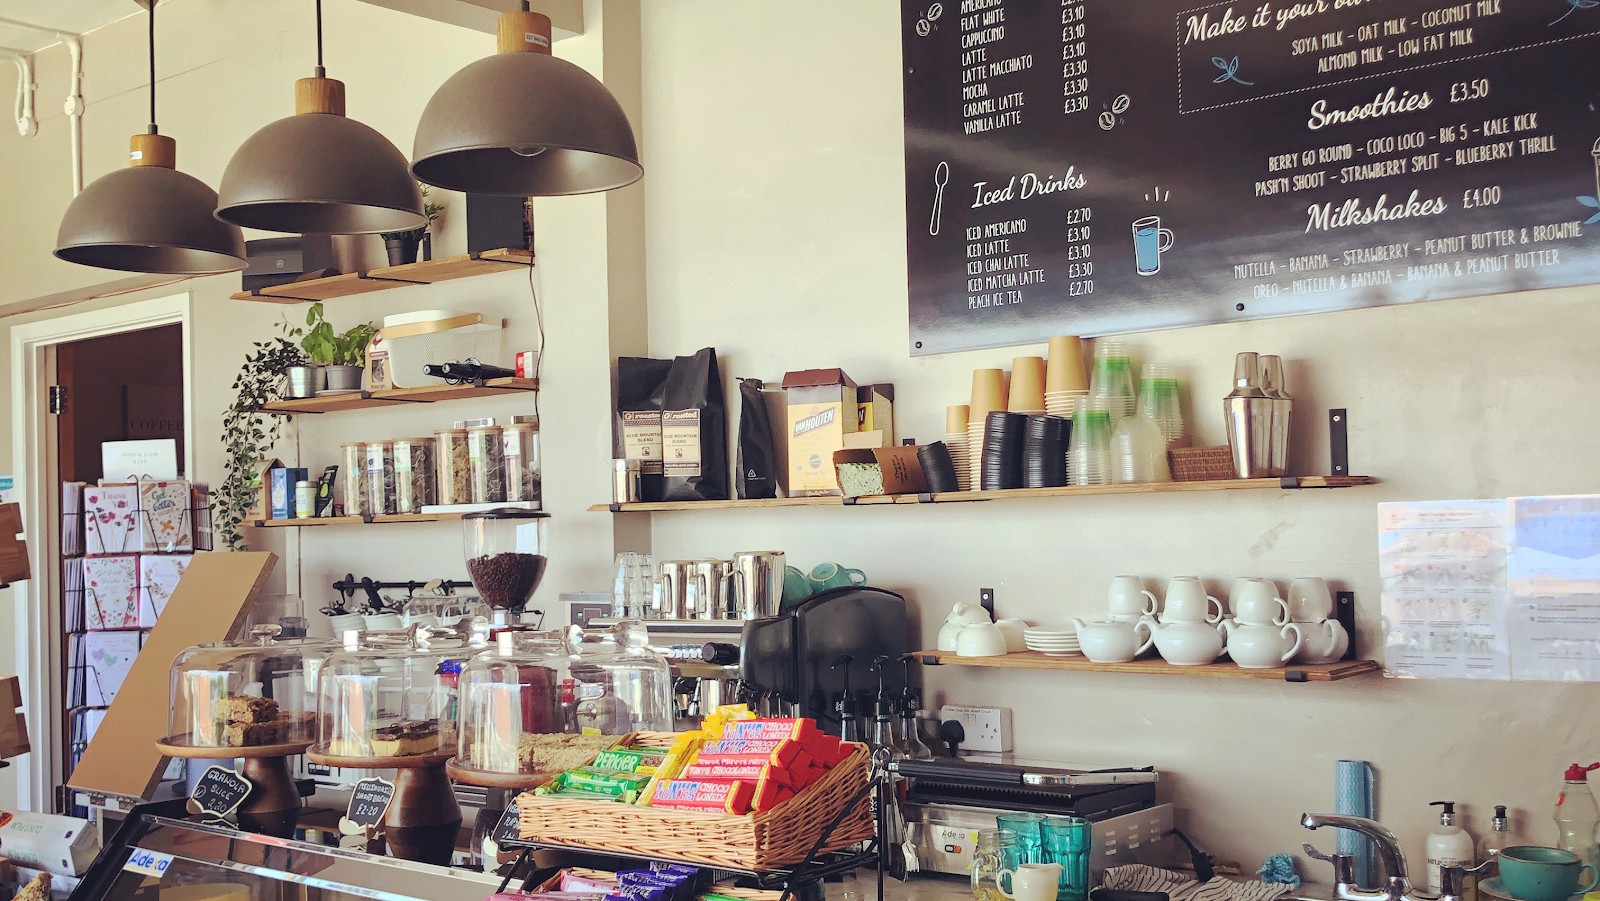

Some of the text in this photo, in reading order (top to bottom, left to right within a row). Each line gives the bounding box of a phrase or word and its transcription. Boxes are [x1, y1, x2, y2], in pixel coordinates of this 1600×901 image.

[961, 8, 1006, 31] FLAT WHITE
[1061, 5, 1085, 24] £3.10
[1183, 7, 1248, 45] Make
[1252, 2, 1272, 28] it
[1276, 0, 1329, 31] your
[961, 25, 1005, 48] CAPPUCCINO
[1062, 23, 1085, 42] £3.10
[1291, 37, 1318, 56] SOYA
[1322, 30, 1344, 50] MILK
[1357, 22, 1380, 43] OAT
[1383, 16, 1406, 36] MILK
[1421, 3, 1472, 29] COCONUT
[1477, 0, 1501, 18] MILK
[961, 48, 987, 66] LATTE
[1062, 41, 1086, 60] £3.10
[1317, 51, 1357, 74] ALMOND
[1361, 46, 1384, 64] MILK
[1398, 39, 1420, 57] LOW
[1423, 33, 1445, 53] FAT
[1449, 28, 1474, 48] MILK
[962, 54, 1033, 83] LATTE MACCHIATO
[1063, 60, 1088, 78] £3.30
[962, 83, 989, 100] MOCHA
[1063, 77, 1088, 96] £3.30
[1450, 78, 1489, 103] £3.50
[963, 92, 1025, 118] CARAMEL LATTE
[1064, 95, 1089, 114] £3.30
[1307, 86, 1434, 130] Smoothies
[964, 110, 1022, 135] VANILLA LATTE
[1268, 153, 1299, 172] BERRY
[1302, 150, 1316, 166] GO
[1319, 143, 1353, 163] ROUND
[1366, 136, 1394, 156] COCO
[1397, 131, 1425, 151] LOCO
[1439, 126, 1456, 144] BIG
[1459, 123, 1468, 141] 5
[1483, 116, 1510, 137] KALE
[1514, 112, 1538, 132] KICK
[1254, 177, 1290, 197] PASH'N
[1292, 171, 1326, 192] SHOOT
[1340, 157, 1407, 184] STRAWBERRY
[1411, 152, 1440, 173] SPLIT
[1455, 140, 1514, 166] BLUEBERRY
[1519, 135, 1556, 156] THRILL
[971, 165, 1087, 208] Iced Drinks
[1462, 185, 1500, 209] £4.00
[1066, 207, 1091, 224] £2.70
[1304, 188, 1448, 234] Milkshakes
[966, 218, 1027, 241] ICED AMERICANO
[1067, 225, 1090, 242] £3.10
[966, 239, 1010, 258] ICED LATTE
[1067, 243, 1091, 260] £3.10
[1234, 260, 1276, 280] NUTELLA
[1289, 253, 1329, 272] BANANA
[1343, 242, 1410, 266] STRAWBERRY
[1425, 235, 1466, 255] PEANUT
[1471, 229, 1516, 250] BUTTER
[1520, 227, 1529, 244] &
[1533, 220, 1583, 242] BROWNIE
[967, 253, 1030, 275] ICED CHAI LATTE
[1068, 261, 1093, 278] £3.30
[1253, 283, 1279, 300] OREO
[1292, 275, 1336, 295] NUTELLA
[1340, 274, 1348, 290] &
[1351, 269, 1393, 288] BANANA
[1407, 262, 1450, 282] BANANA
[1454, 260, 1463, 277] &
[1467, 254, 1509, 275] PEANUT
[1514, 249, 1560, 270] BUTTER
[967, 269, 1046, 292] ICED MATCHA LATTE
[1069, 279, 1094, 296] £2.70
[968, 290, 1023, 309] PEACH ICE TEA
[112, 500, 129, 509] YU
[765, 722, 794, 731] CHOCO
[207, 770, 246, 793] GRANOLA
[210, 784, 234, 800] SLICE
[700, 782, 730, 793] CHOCO
[941, 830, 965, 839] Adea
